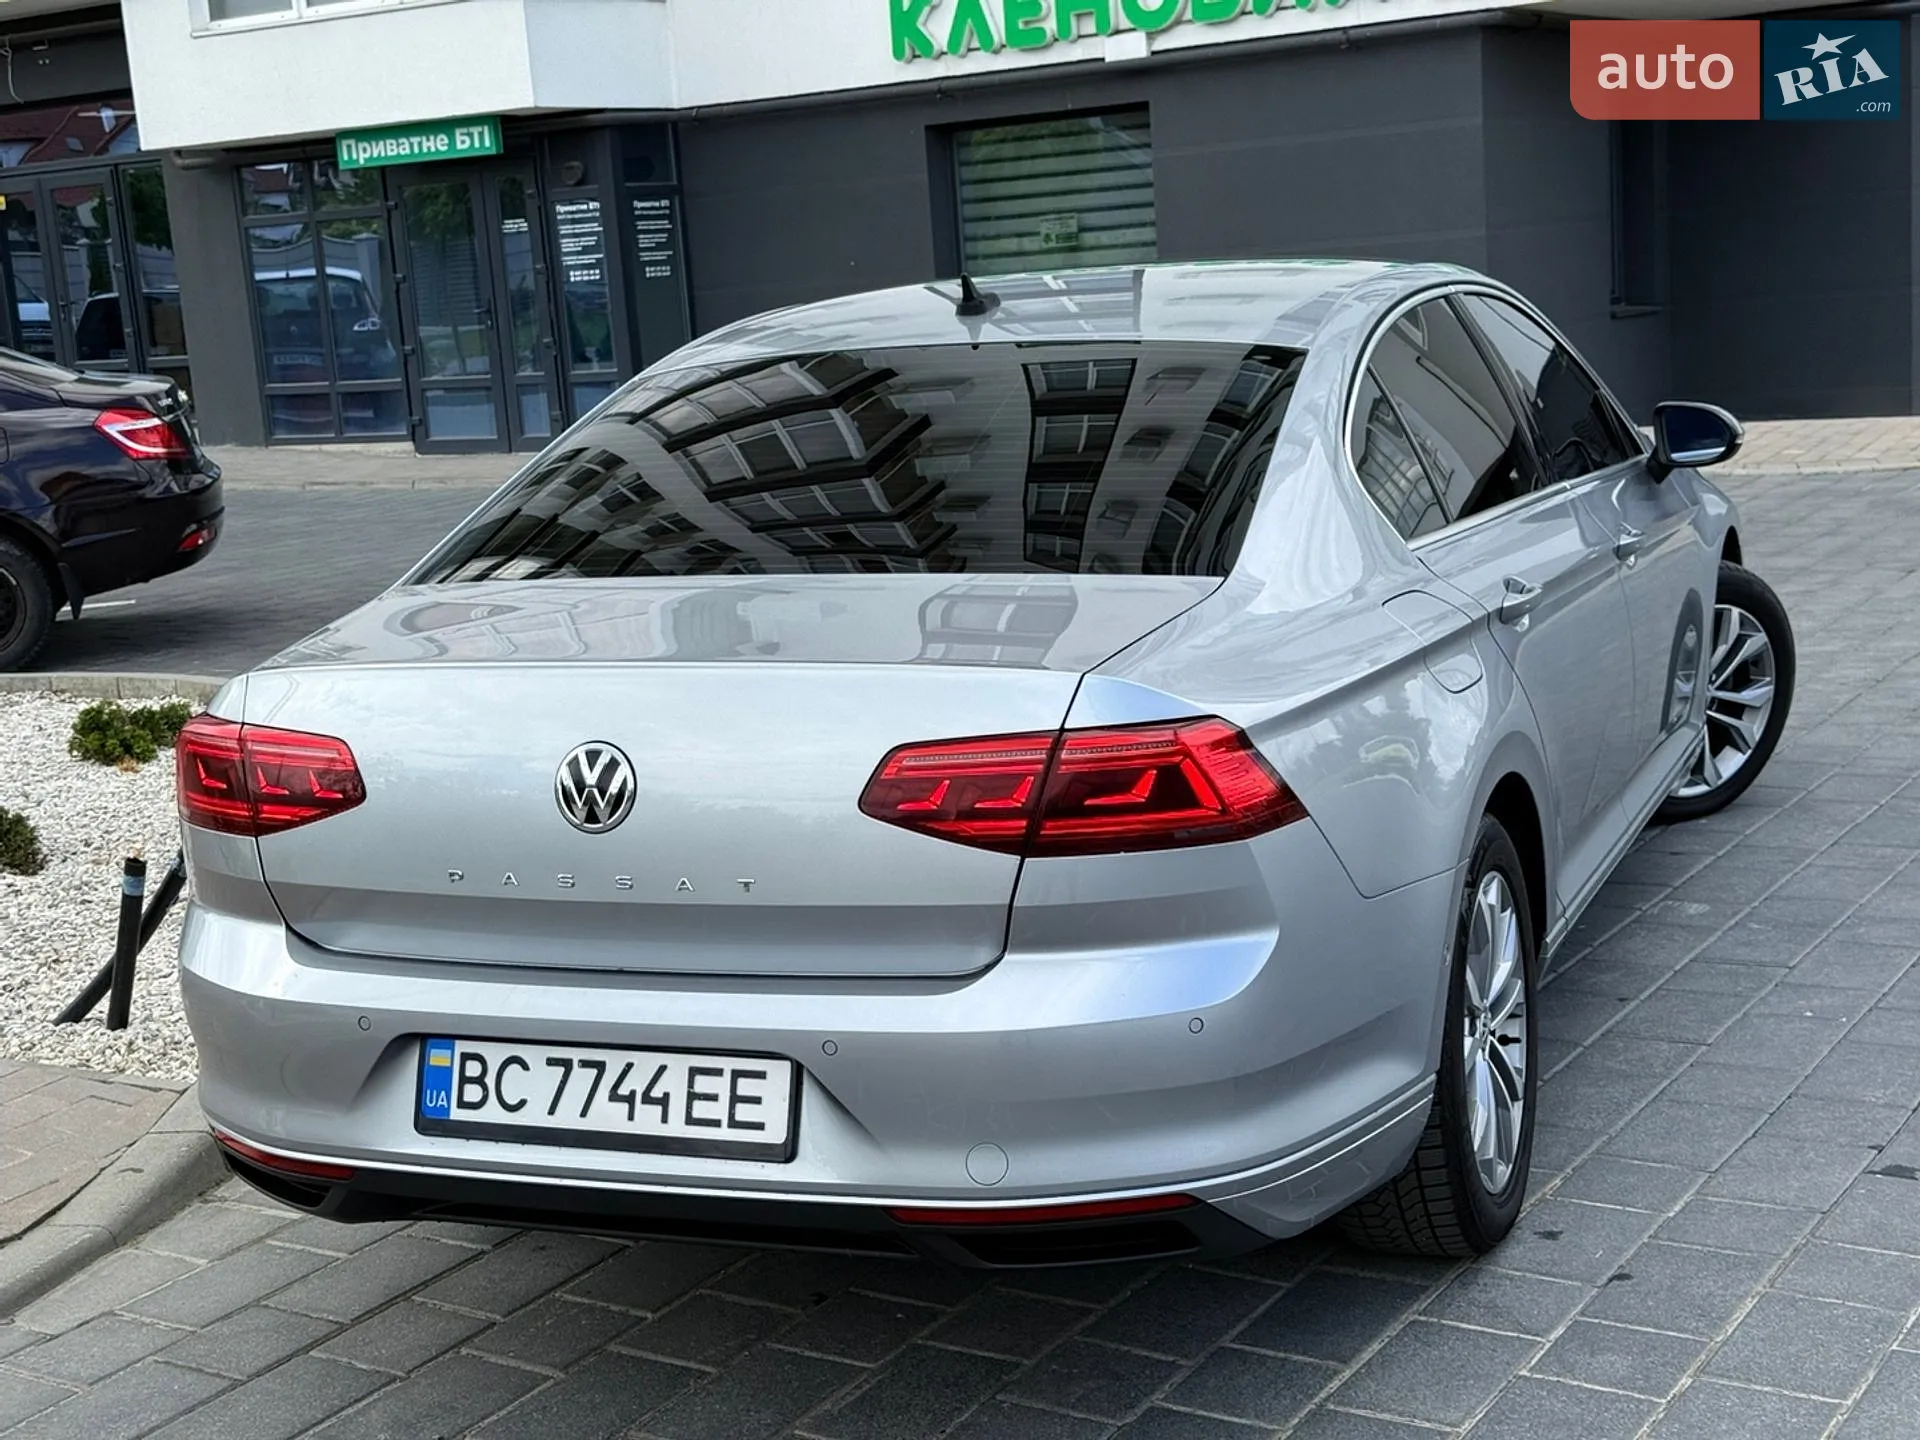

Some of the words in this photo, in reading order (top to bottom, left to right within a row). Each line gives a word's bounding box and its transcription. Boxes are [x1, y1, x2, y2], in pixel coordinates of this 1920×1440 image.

[340, 133, 449, 165] Приватне
[454, 125, 491, 150] БТІ
[447, 868, 757, 893] PASSAT
[425, 1089, 449, 1110] UA
[455, 1051, 529, 1114] BC
[545, 1056, 671, 1125] 7744
[683, 1066, 768, 1132] EE
